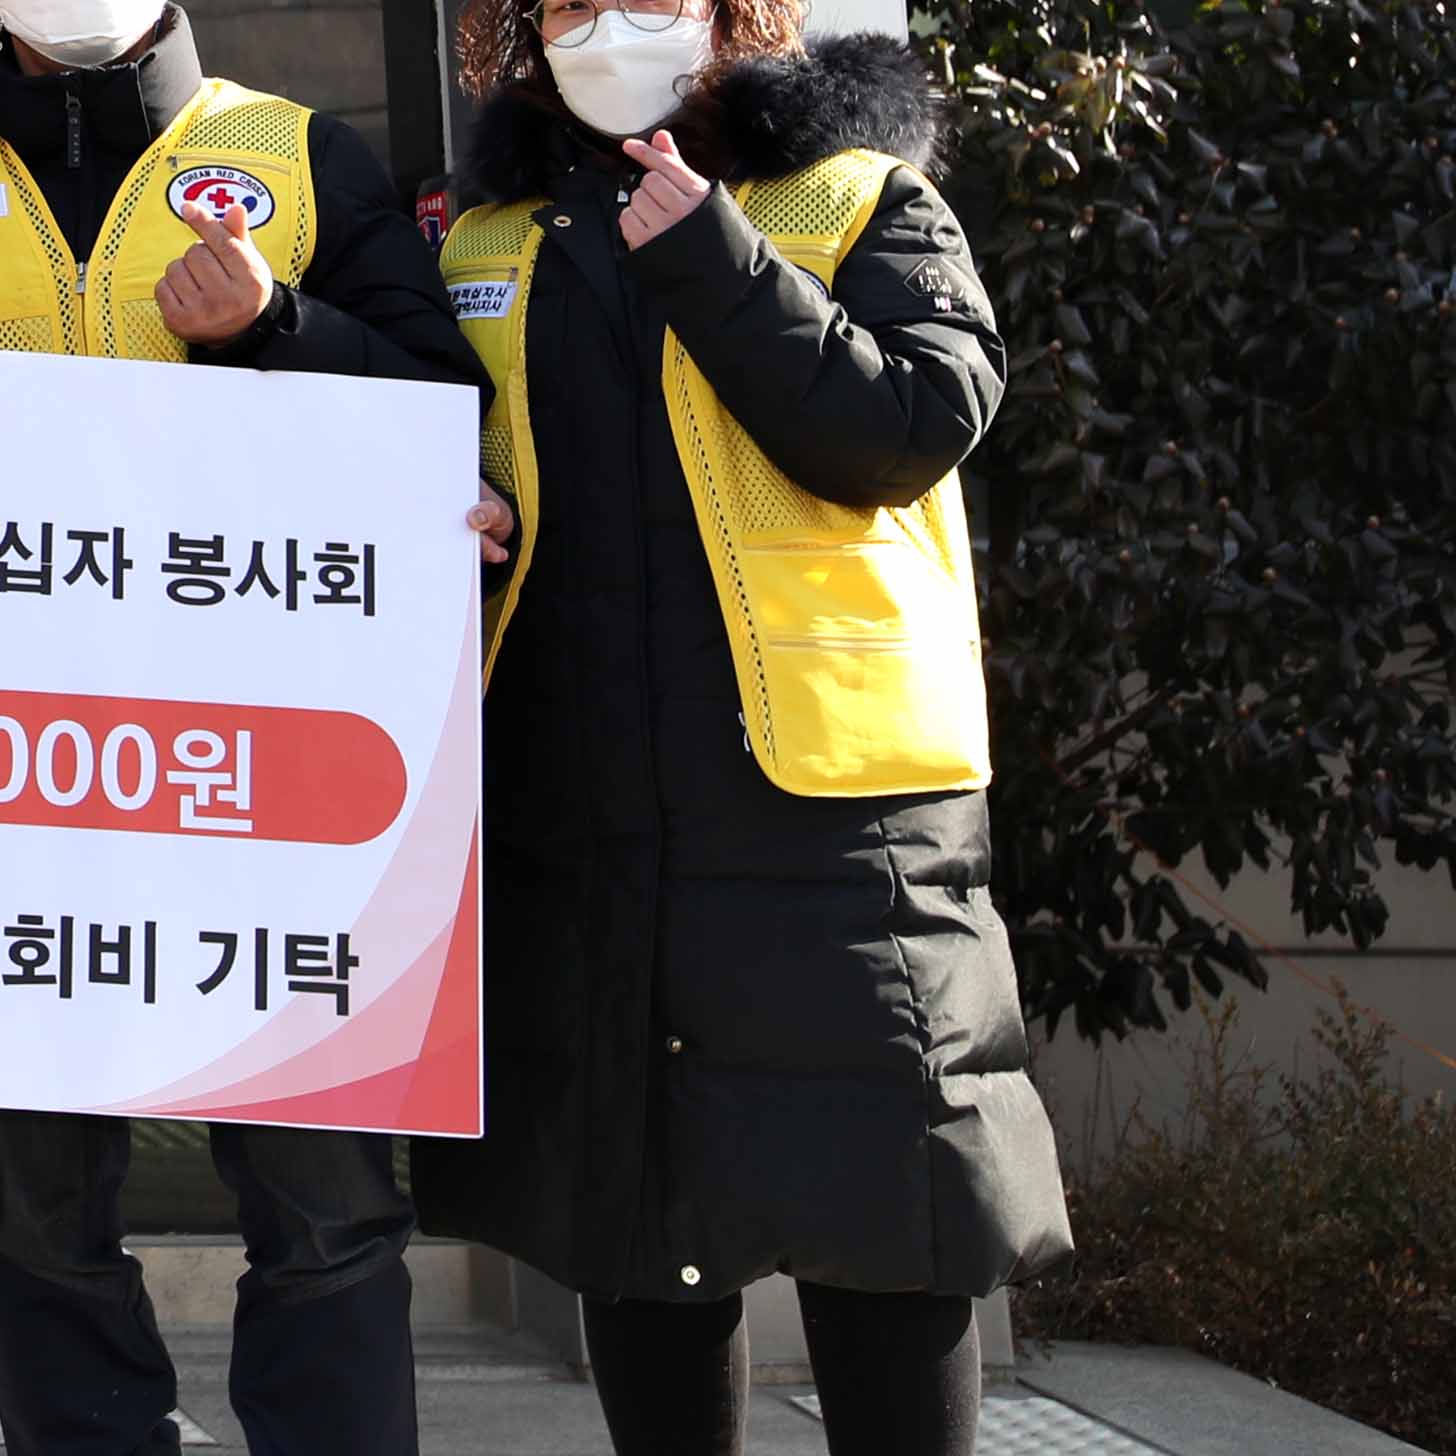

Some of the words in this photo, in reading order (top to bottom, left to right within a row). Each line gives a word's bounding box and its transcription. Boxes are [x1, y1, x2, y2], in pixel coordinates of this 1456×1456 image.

[178, 169, 211, 187] KOREAN
[216, 169, 234, 179] RED
[239, 175, 266, 198] CROSS
[161, 532, 377, 617] 봉사회
[196, 927, 359, 1017] 기탁
